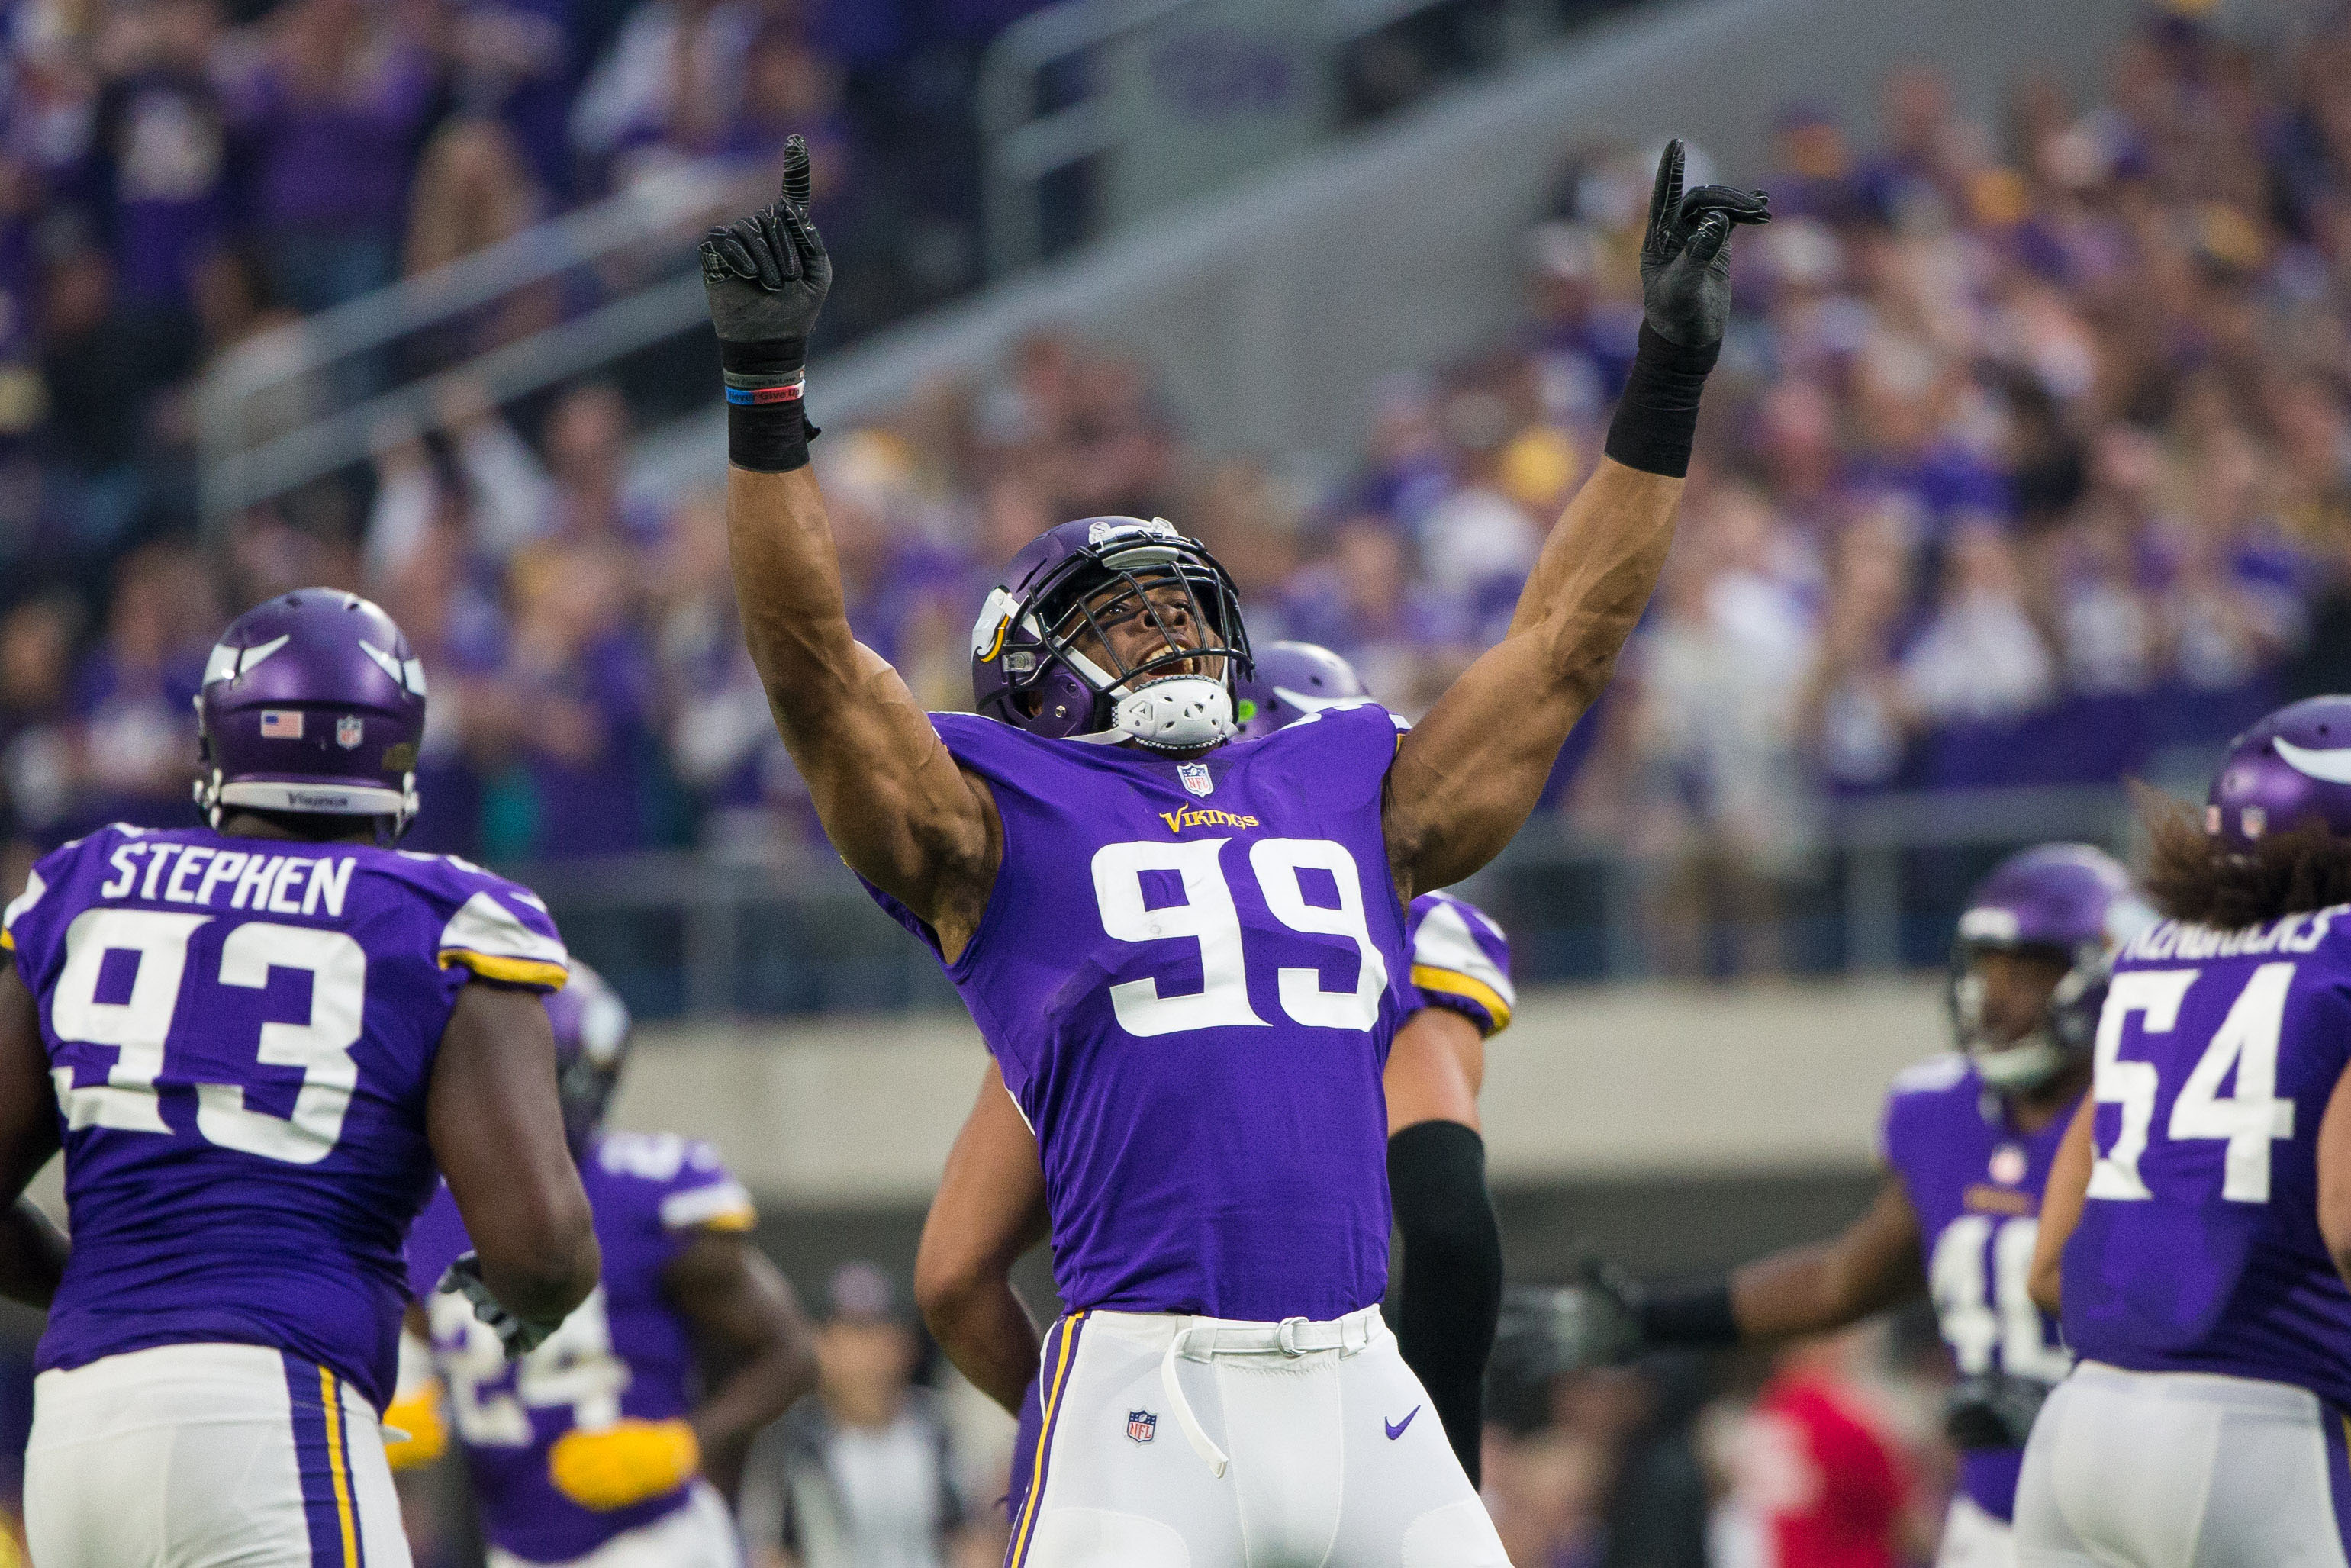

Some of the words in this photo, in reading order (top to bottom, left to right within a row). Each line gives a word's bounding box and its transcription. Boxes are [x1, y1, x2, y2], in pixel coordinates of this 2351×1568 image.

[758, 390, 786, 401] Give
[787, 388, 800, 399] Up
[1187, 777, 1209, 790] NFL
[102, 841, 356, 916] STEPHEN
[1090, 837, 1389, 1038] 99
[50, 907, 367, 1165] 93
[2085, 961, 2296, 1203] 54
[1129, 1422, 1152, 1439] NFL
